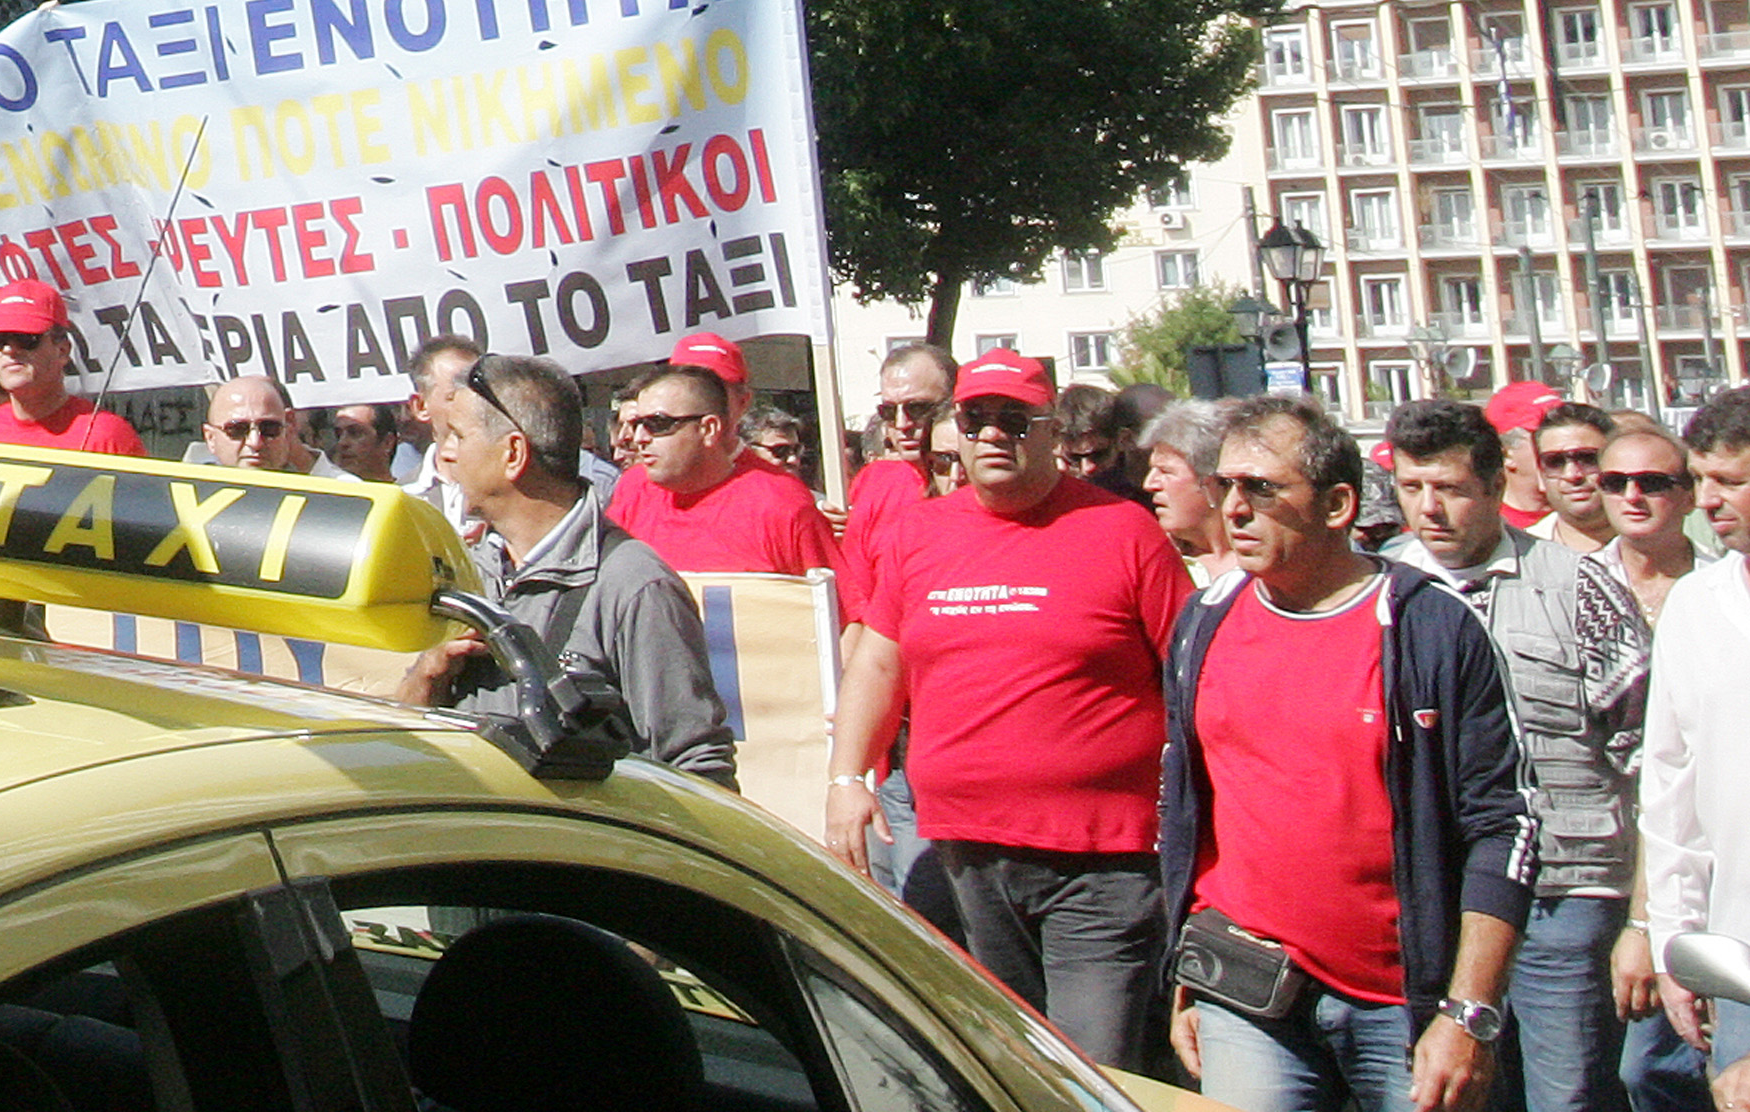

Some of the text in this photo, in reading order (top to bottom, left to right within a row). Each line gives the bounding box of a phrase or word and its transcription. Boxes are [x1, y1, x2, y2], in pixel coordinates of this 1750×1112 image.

[44, 6, 230, 98] ΤΑΞΙ
[230, 89, 392, 182] ΠΟΤΕ
[405, 28, 752, 157] ΝΙΚΗΜΕΝΟ
[425, 129, 777, 262] ΠΟΛΙΤΙΚΟΙ
[93, 300, 187, 367] ΤΑ
[506, 271, 611, 356] ΤΟ
[626, 233, 798, 334] ΤΑΞΙ
